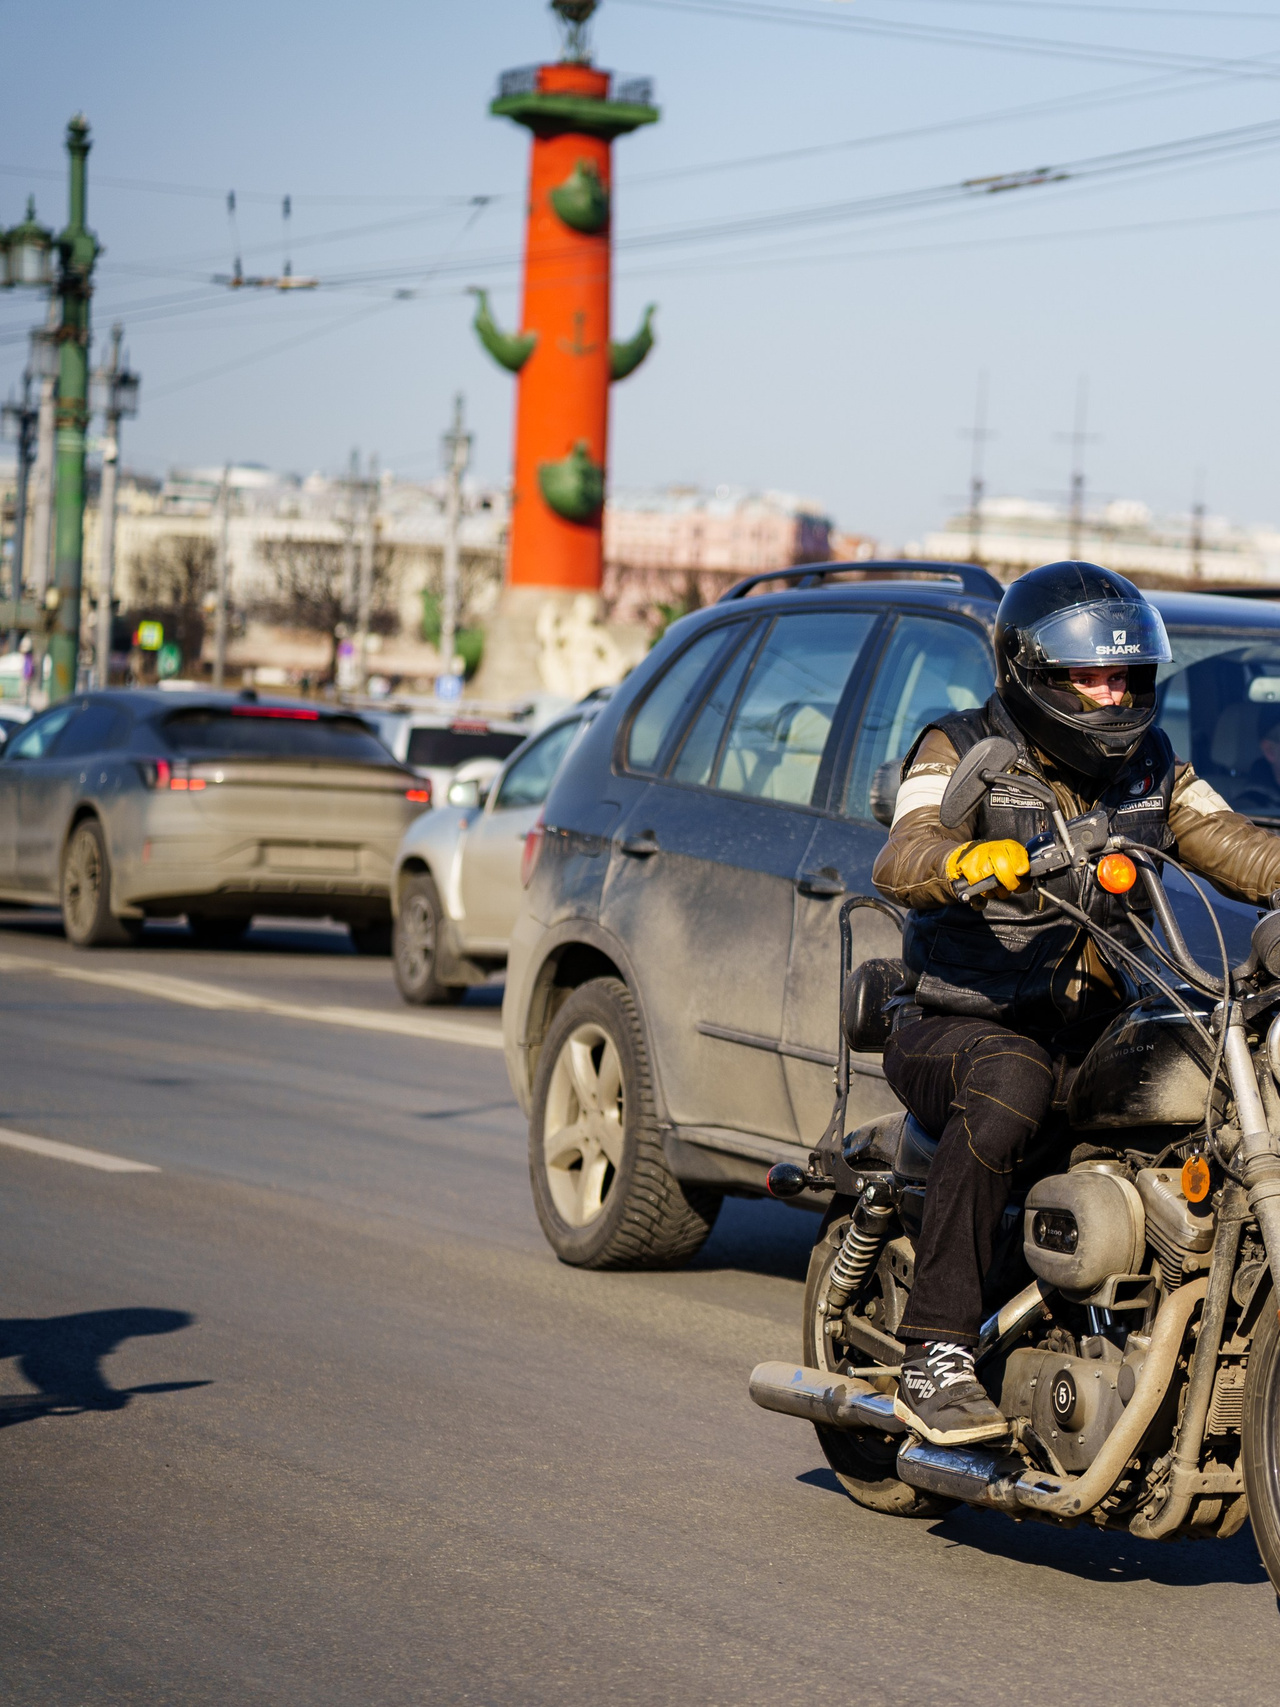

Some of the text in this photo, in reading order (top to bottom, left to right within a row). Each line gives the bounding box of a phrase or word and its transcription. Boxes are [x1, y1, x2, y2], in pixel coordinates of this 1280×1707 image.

[1095, 643, 1141, 655] SHARK
[1119, 799, 1161, 811] СКИТАЛЬЦЫ
[1047, 1228, 1062, 1236] 1200
[1058, 1387, 1067, 1405] 5
